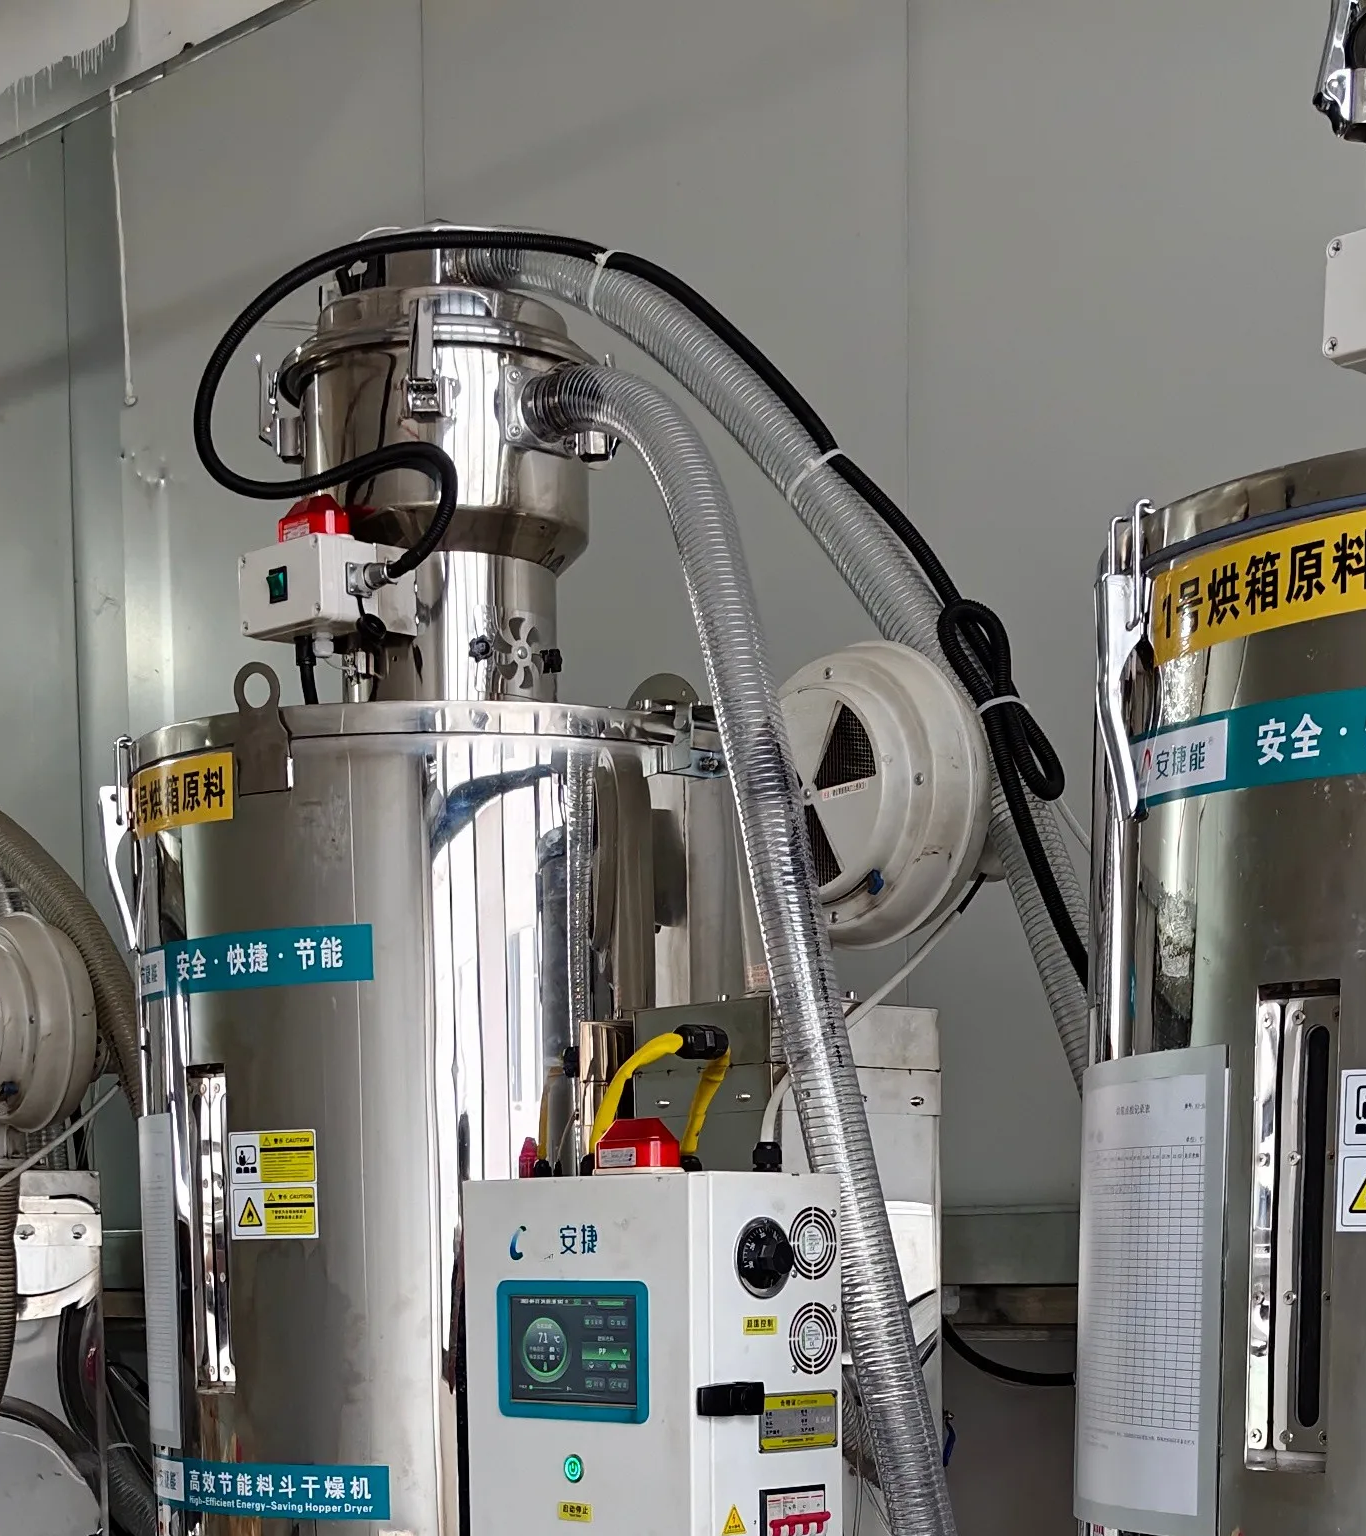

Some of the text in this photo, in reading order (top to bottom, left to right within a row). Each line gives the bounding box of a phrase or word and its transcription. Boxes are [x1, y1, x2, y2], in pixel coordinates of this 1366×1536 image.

[1155, 740, 1208, 779] 安捷能
[559, 1224, 598, 1255] 安捷
[188, 1469, 372, 1500] 高效节能料斗干燥机
[236, 1500, 303, 1514] Energy-Saving
[305, 1502, 342, 1515] Hopper
[344, 1503, 373, 1515] Dryer
